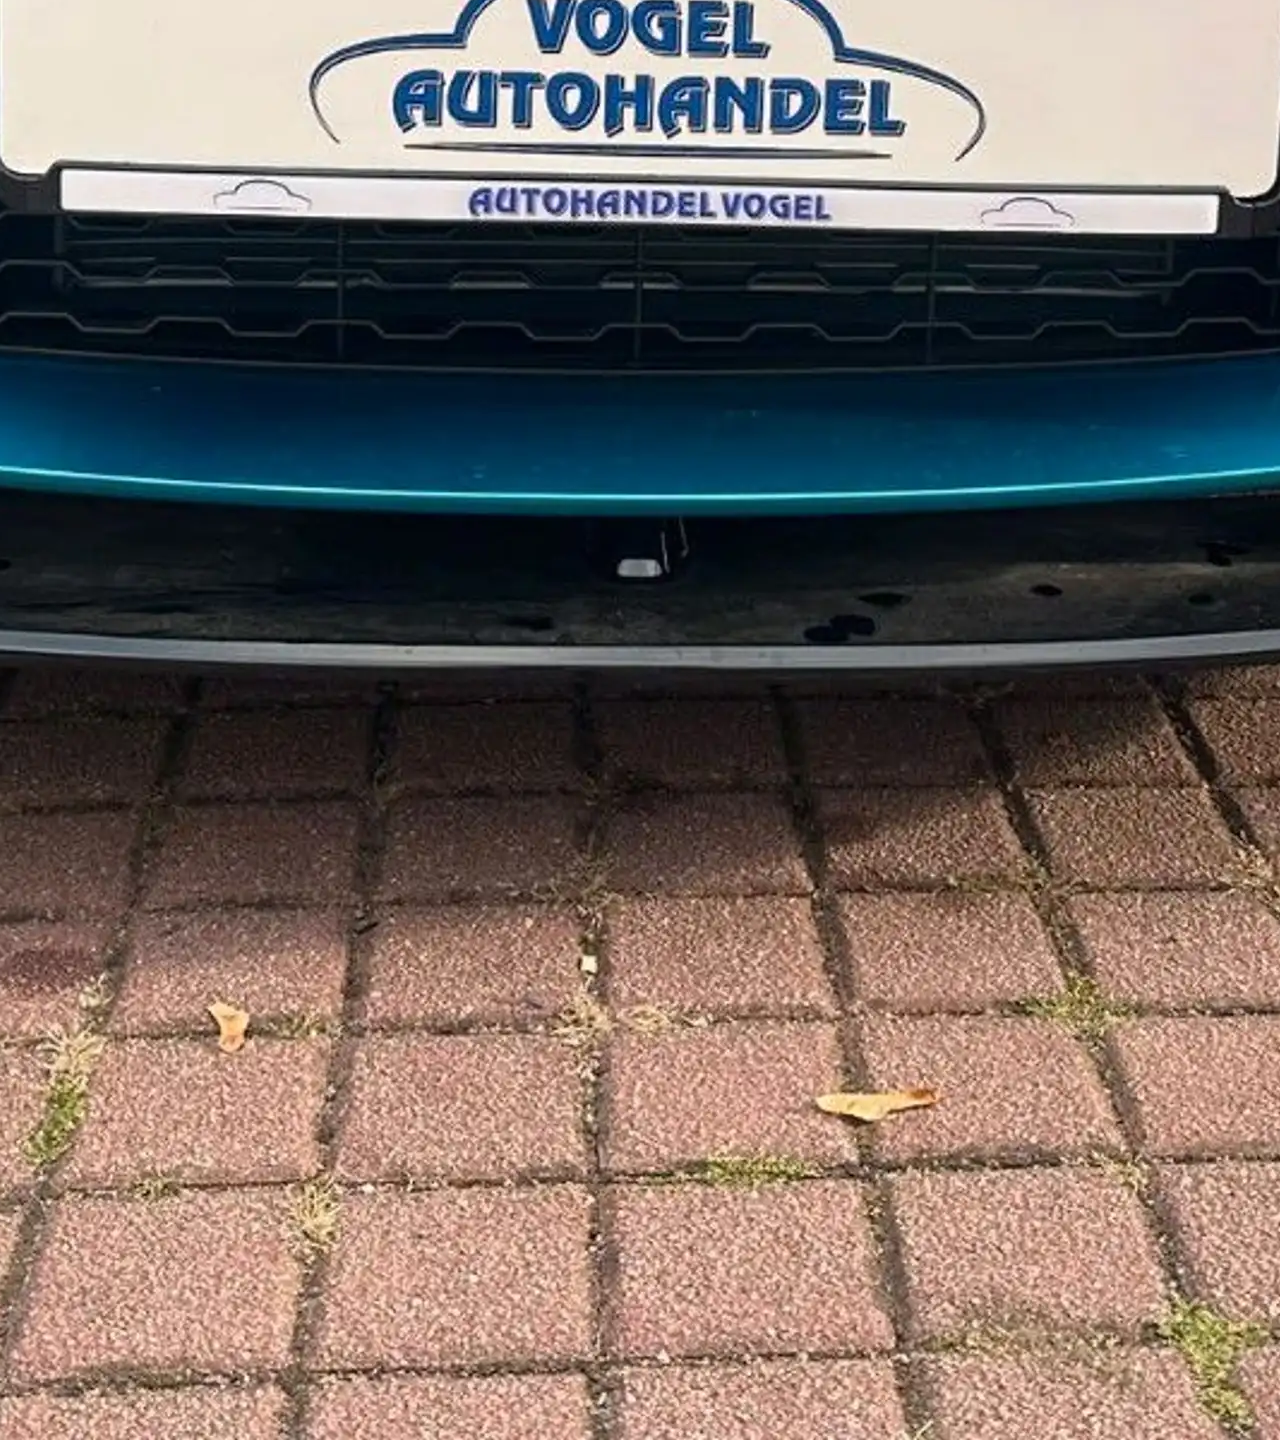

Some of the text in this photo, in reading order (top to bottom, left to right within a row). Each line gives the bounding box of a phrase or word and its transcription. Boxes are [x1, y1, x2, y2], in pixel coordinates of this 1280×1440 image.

[392, 69, 906, 138] AUTOHANDEL
[468, 186, 832, 221] AUTOHANDEL VOGEL
